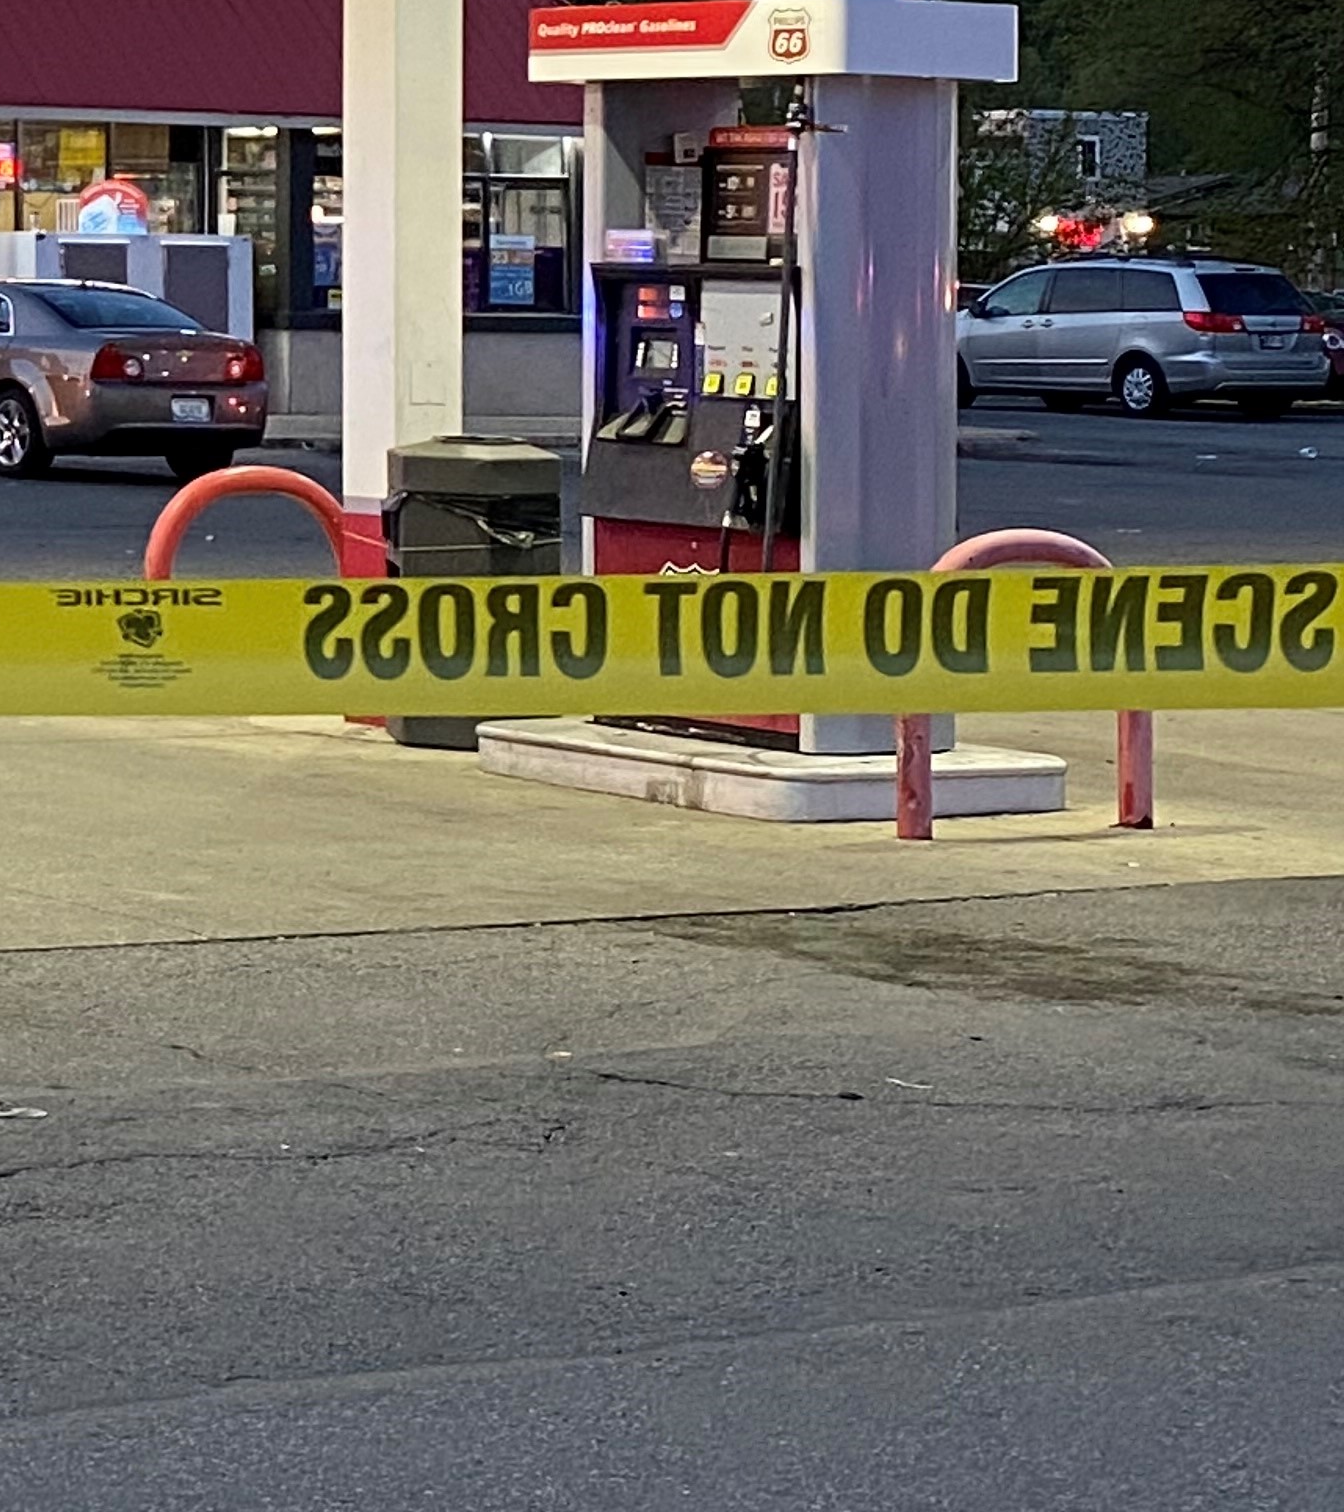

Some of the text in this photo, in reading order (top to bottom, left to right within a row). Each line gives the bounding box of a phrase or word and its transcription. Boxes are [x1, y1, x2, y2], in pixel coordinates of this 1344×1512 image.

[537, 23, 580, 38] Quality
[639, 19, 697, 33] Gasolines
[775, 31, 804, 54] 66
